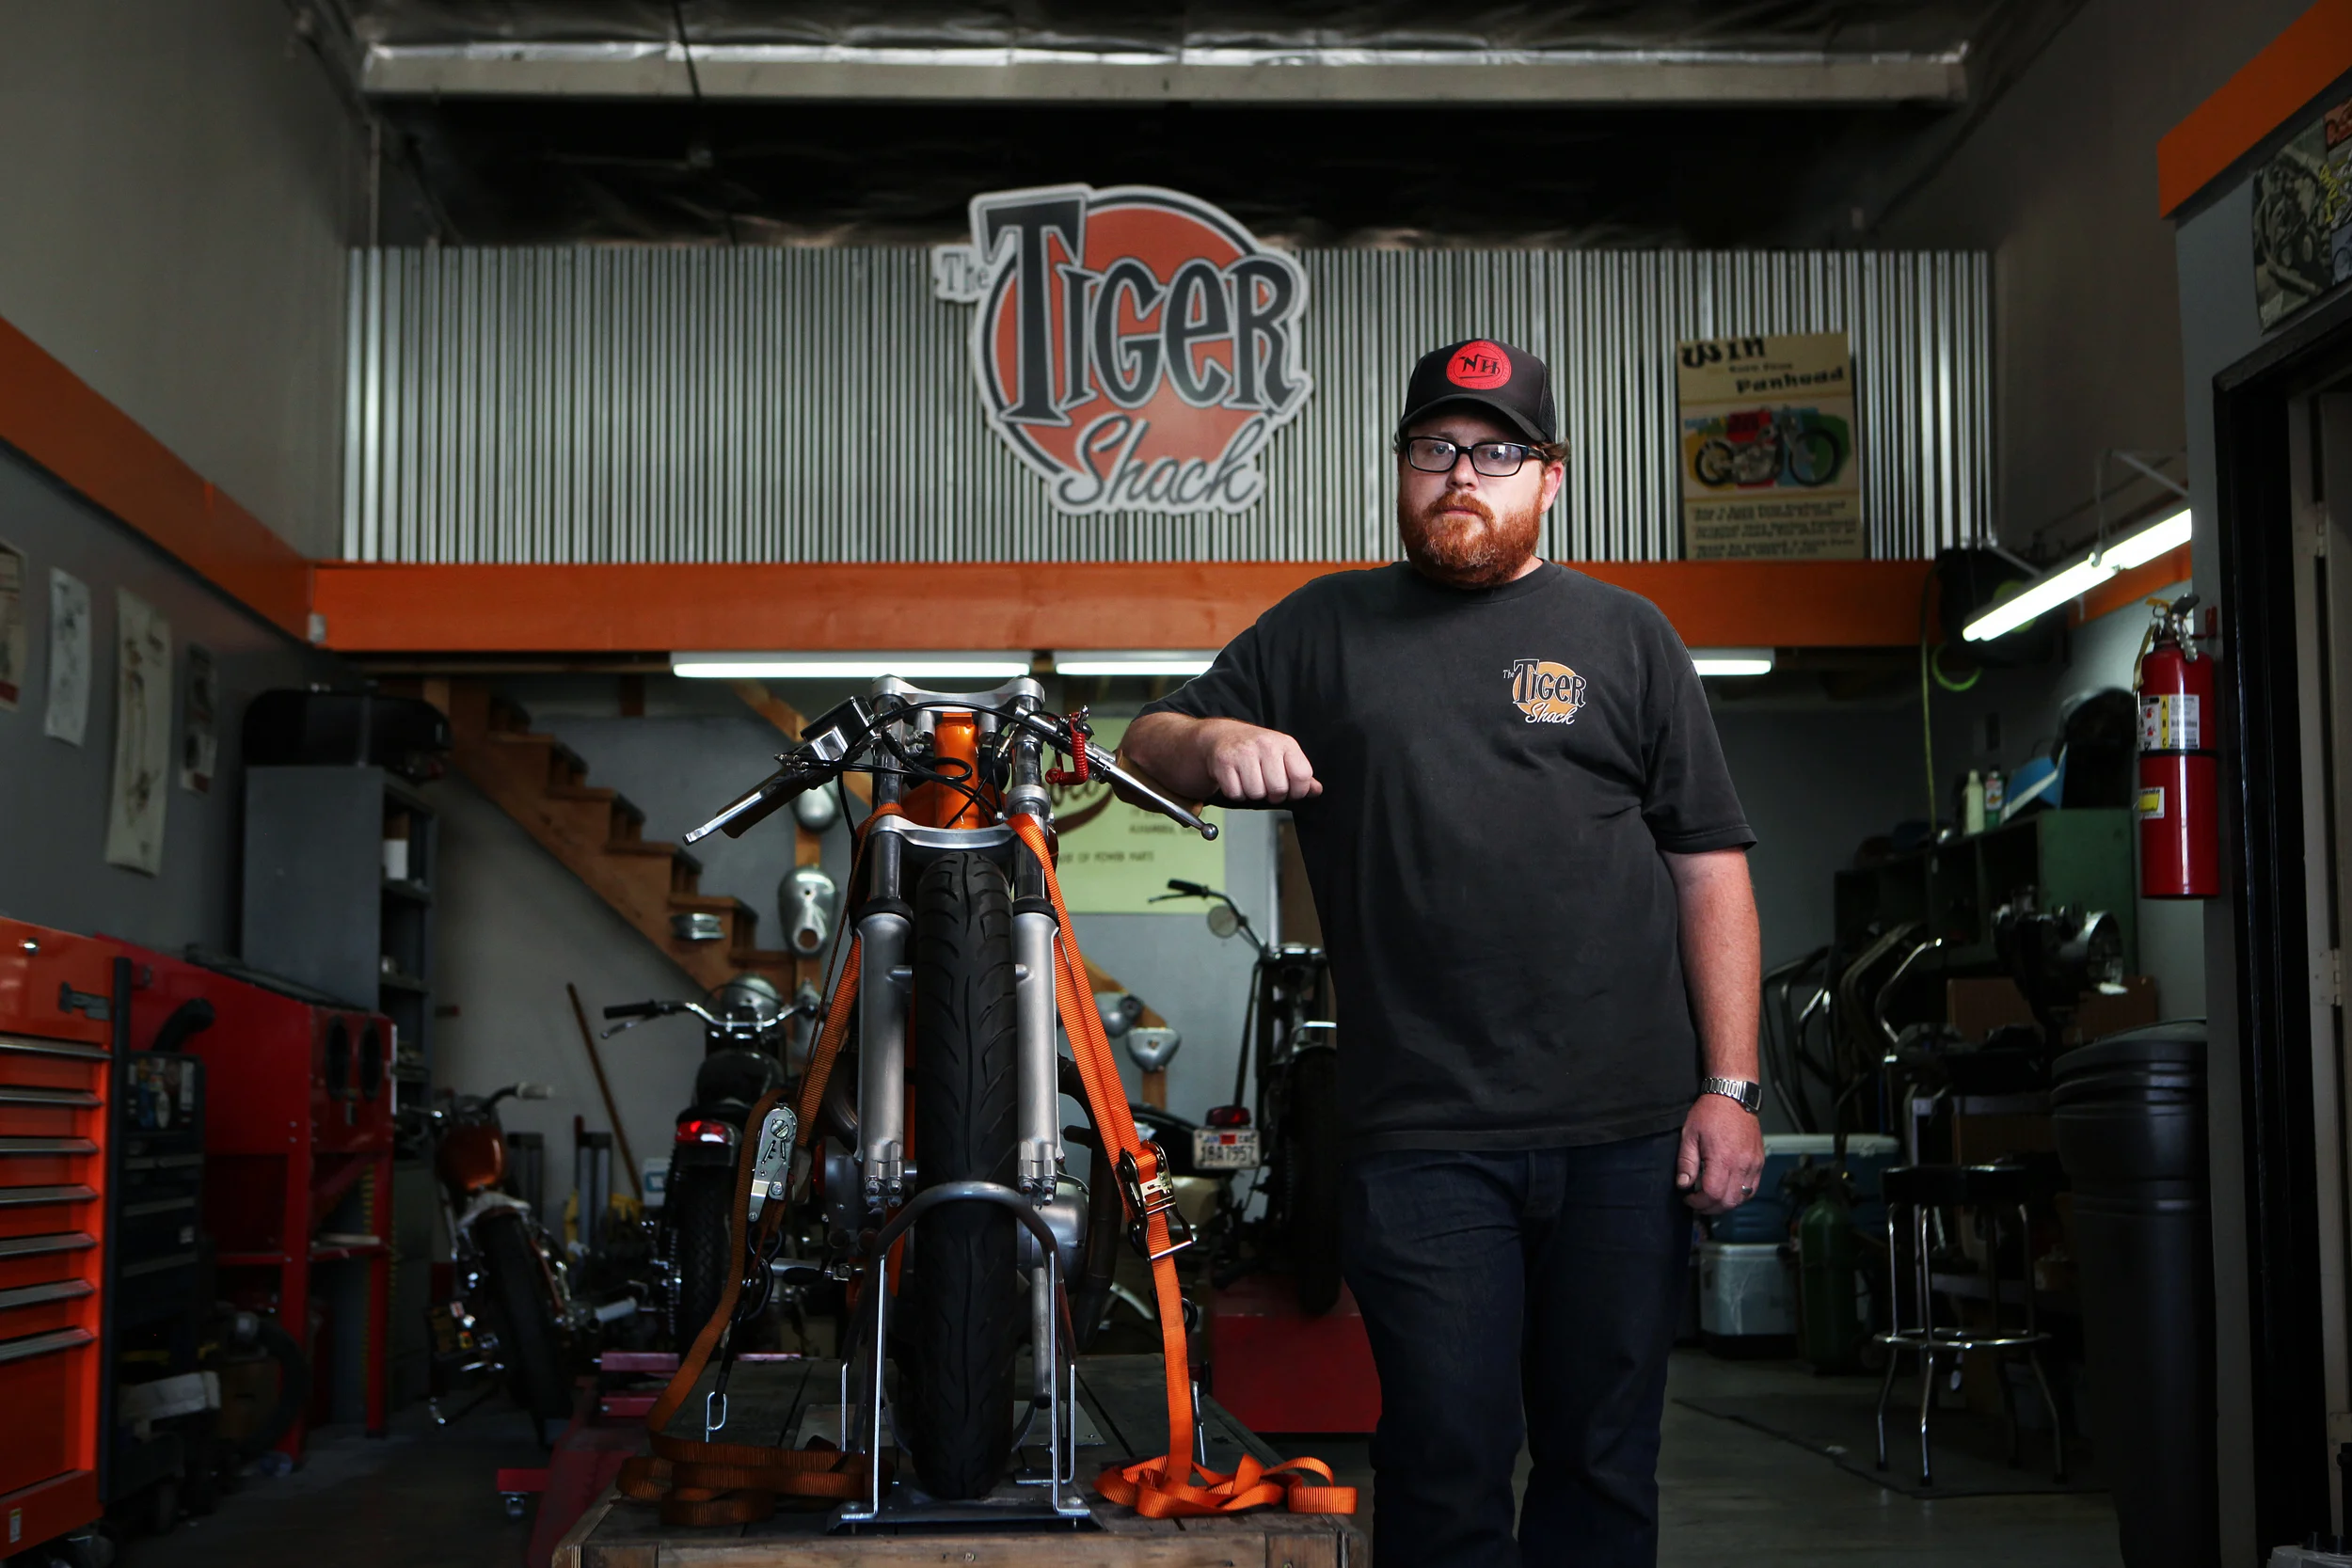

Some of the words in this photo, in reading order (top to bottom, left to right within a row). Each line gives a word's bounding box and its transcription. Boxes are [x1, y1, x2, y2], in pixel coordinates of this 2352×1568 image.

[942, 251, 990, 293] The
[1058, 412, 1266, 506] Shack
[1502, 669, 1515, 679] The
[1525, 702, 1578, 724] Shack
